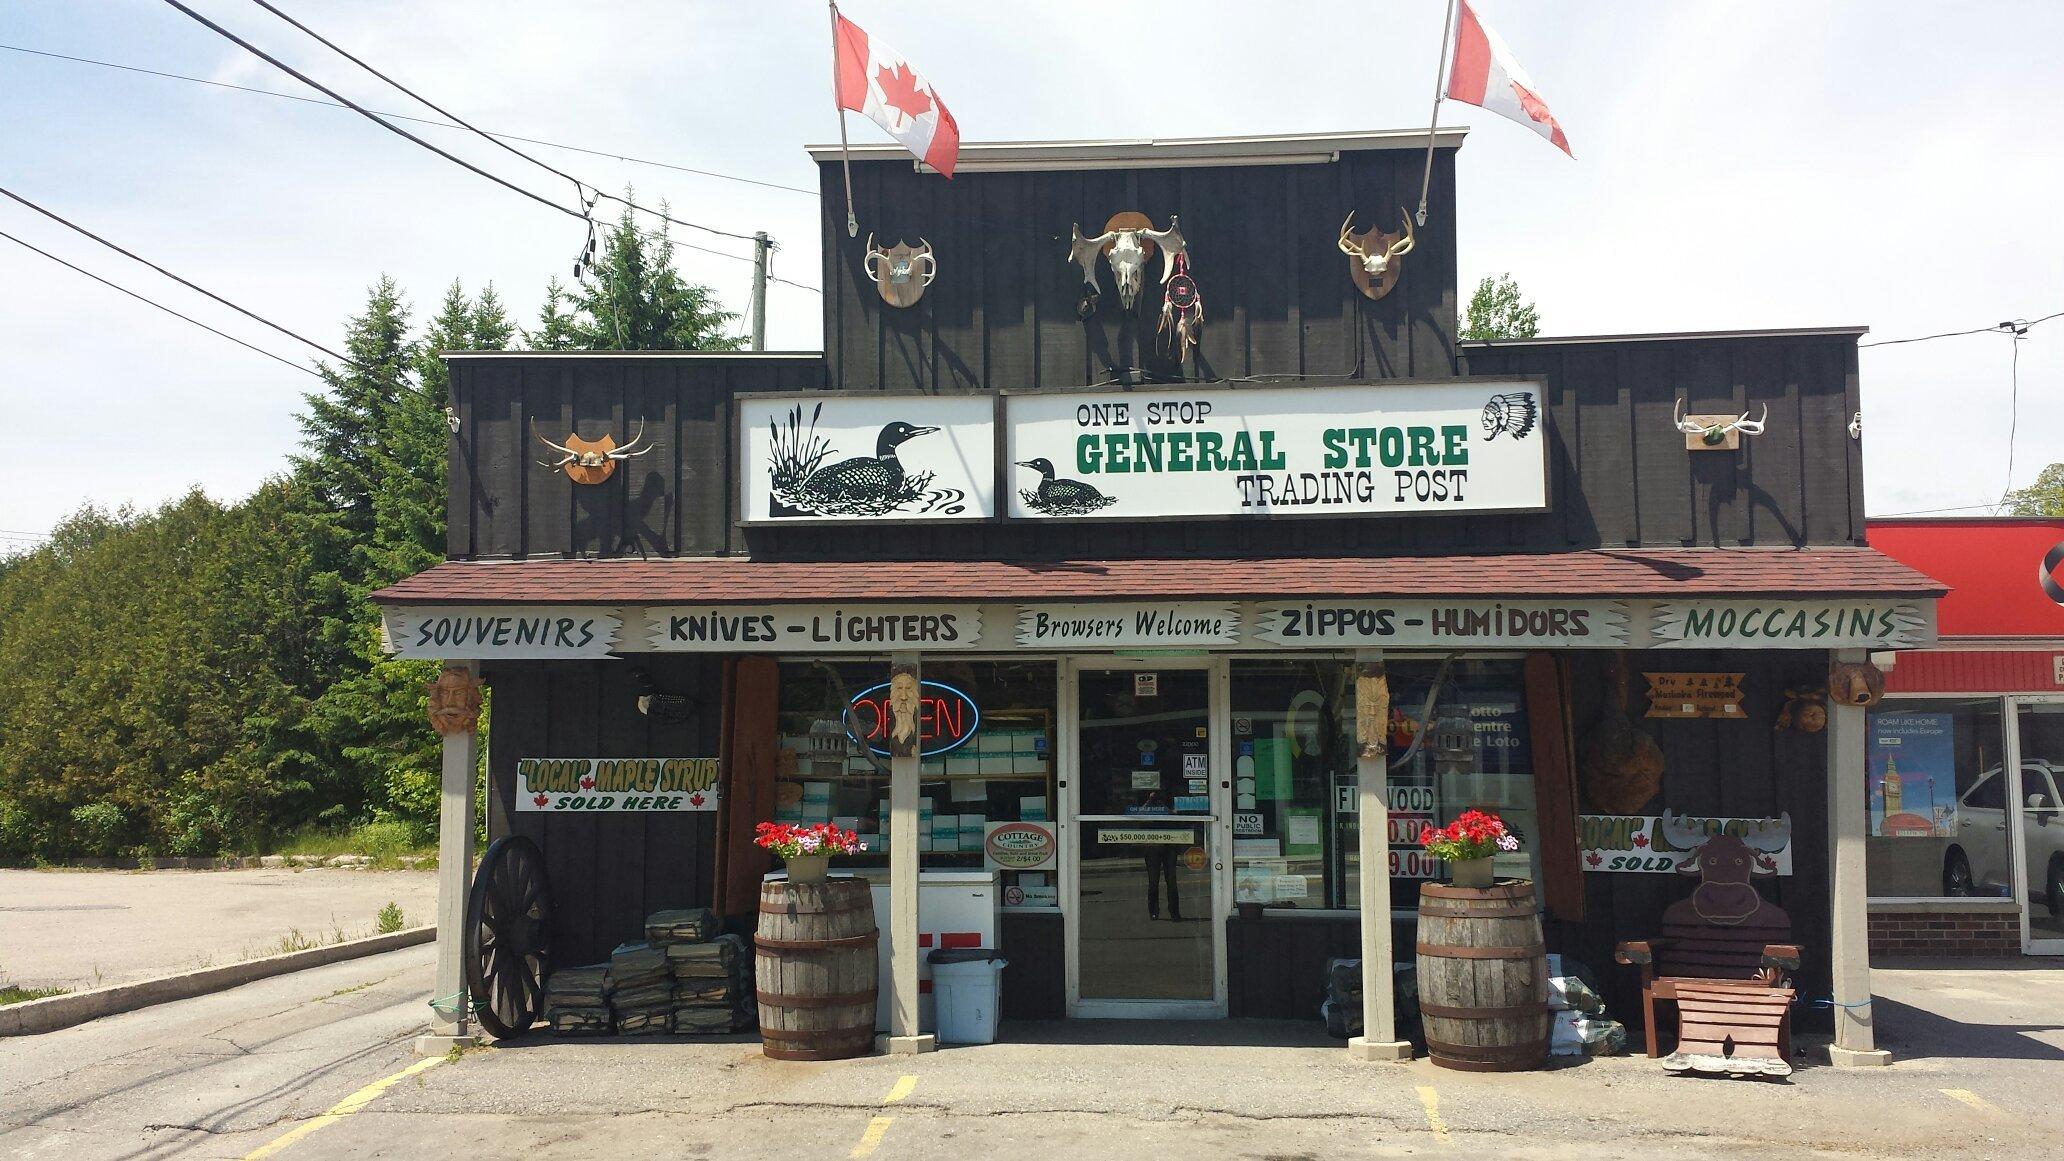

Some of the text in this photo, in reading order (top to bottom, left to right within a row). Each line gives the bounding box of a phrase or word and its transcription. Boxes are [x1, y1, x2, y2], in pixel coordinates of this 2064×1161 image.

[1077, 401, 1212, 427] ONE STOP
[1076, 425, 1469, 475] GENERAL STORE
[1237, 469, 1468, 507] TRADING POST
[1035, 610, 1222, 639] Browsers Welcome
[1684, 607, 1896, 638] MOCCASINS
[415, 617, 595, 648] SOUVENIRS
[1469, 705, 1502, 717] otto
[1473, 720, 1512, 732] entre
[1877, 718, 1899, 726] ROAM
[1915, 718, 1937, 726] HOME
[1185, 757, 1206, 768] ATM
[594, 758, 660, 794] MAPLE
[660, 758, 719, 795] SYRUP
[554, 796, 684, 810] SOLD HERE
[1239, 815, 1258, 824] NO
[997, 832, 1044, 842] COTTAGE
[1608, 856, 1674, 871] SOLD
